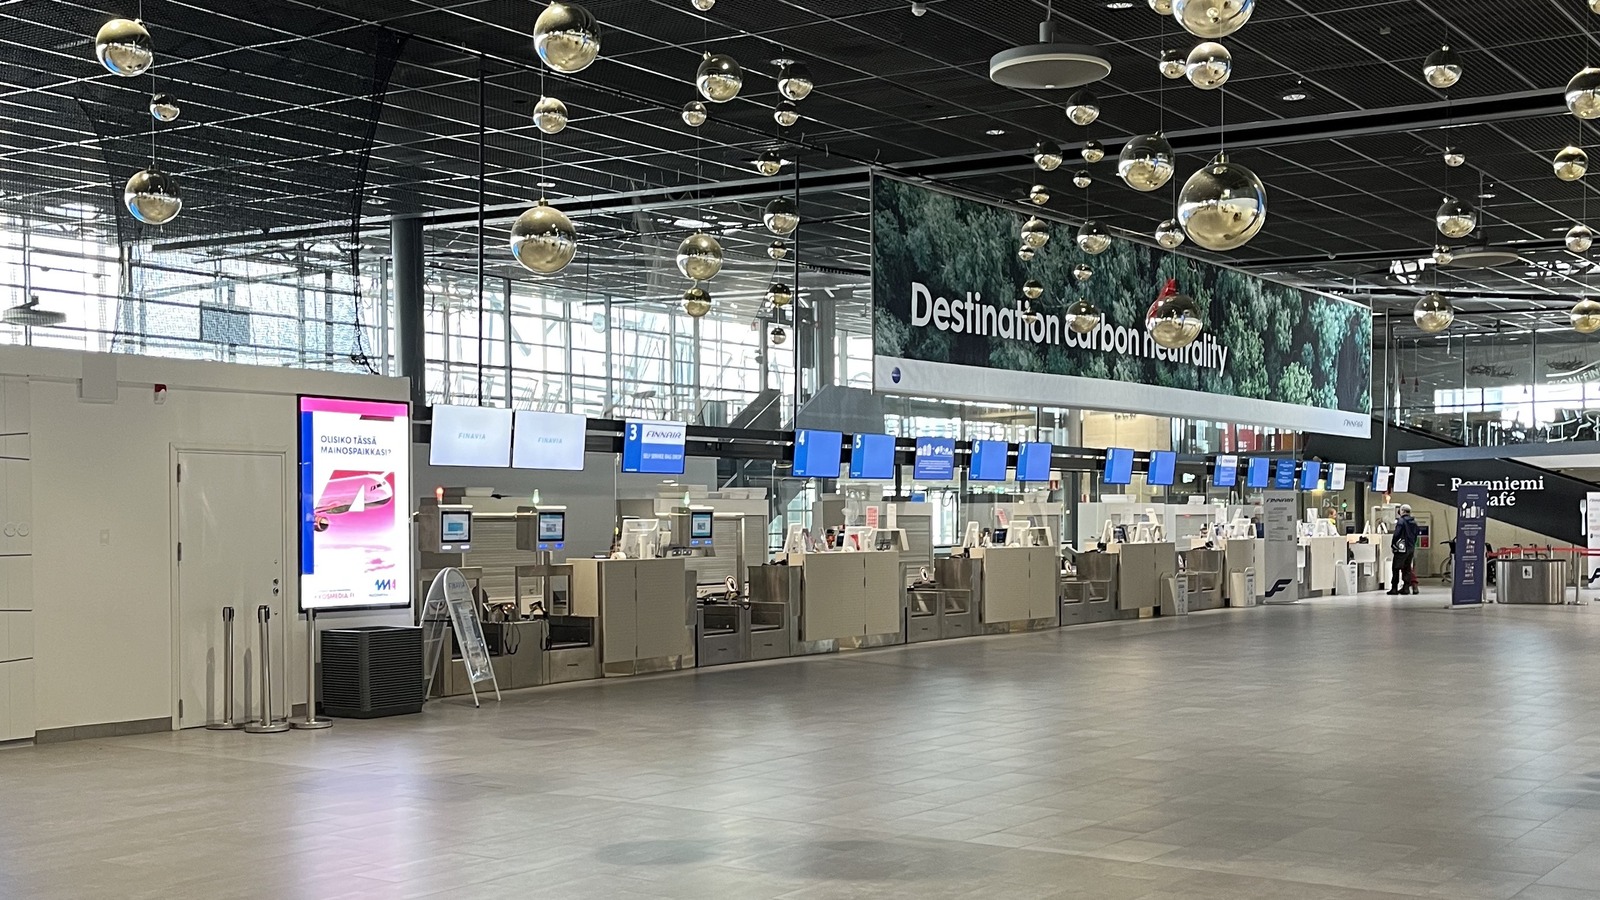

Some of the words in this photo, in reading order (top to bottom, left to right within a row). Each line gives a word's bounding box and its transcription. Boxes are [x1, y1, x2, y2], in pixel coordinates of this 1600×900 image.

[911, 281, 1060, 345] Destination
[1064, 313, 1139, 356] carbon
[458, 432, 486, 440] FINAVIA
[629, 424, 637, 441] 3
[646, 430, 682, 439] FINNAIR
[798, 430, 805, 446] 4
[320, 434, 352, 444] OLISIKO
[353, 434, 377, 445] TÄSSÄ
[537, 436, 563, 444] FINAVIA
[855, 434, 862, 449] 5
[320, 446, 392, 456] MAINOSPAIKKASI?
[974, 440, 980, 454] 6
[1021, 443, 1026, 455] 7
[1108, 448, 1113, 460] 8
[1151, 451, 1156, 462] 9
[1486, 491, 1516, 506] afé
